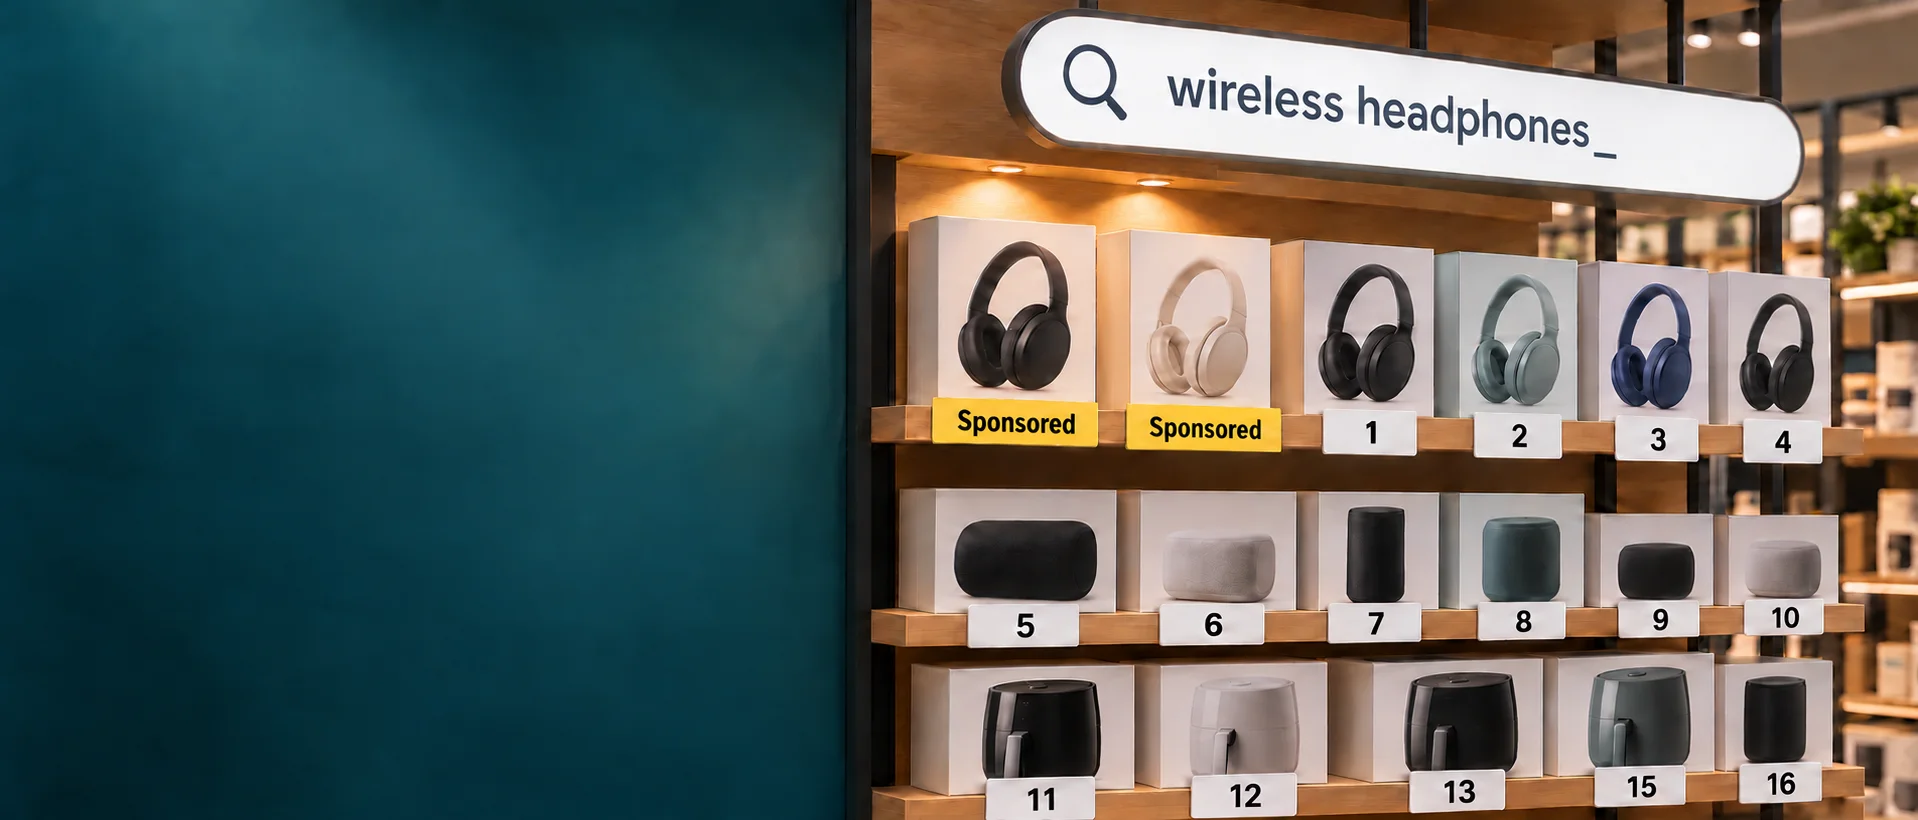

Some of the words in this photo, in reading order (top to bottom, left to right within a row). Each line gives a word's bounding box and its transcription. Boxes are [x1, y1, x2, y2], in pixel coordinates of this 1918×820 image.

[1167, 67, 1344, 123] wireless
[957, 408, 1076, 437] Sponsored
[1149, 415, 1262, 443] Sponsored
[1365, 420, 1377, 445] 1
[1512, 423, 1528, 448] 2
[1650, 427, 1667, 452] 3
[1774, 430, 1792, 454] 4
[1016, 613, 1035, 639] 5
[1204, 612, 1223, 637] 6
[1368, 611, 1385, 636] 7
[1515, 609, 1532, 633] 8
[1652, 608, 1669, 632] 9
[1771, 606, 1800, 629] 10
[1230, 783, 1262, 808] 12
[1444, 779, 1476, 804] 13
[1627, 775, 1657, 799] 15
[1767, 771, 1796, 796] 16
[1027, 787, 1055, 812] 11
